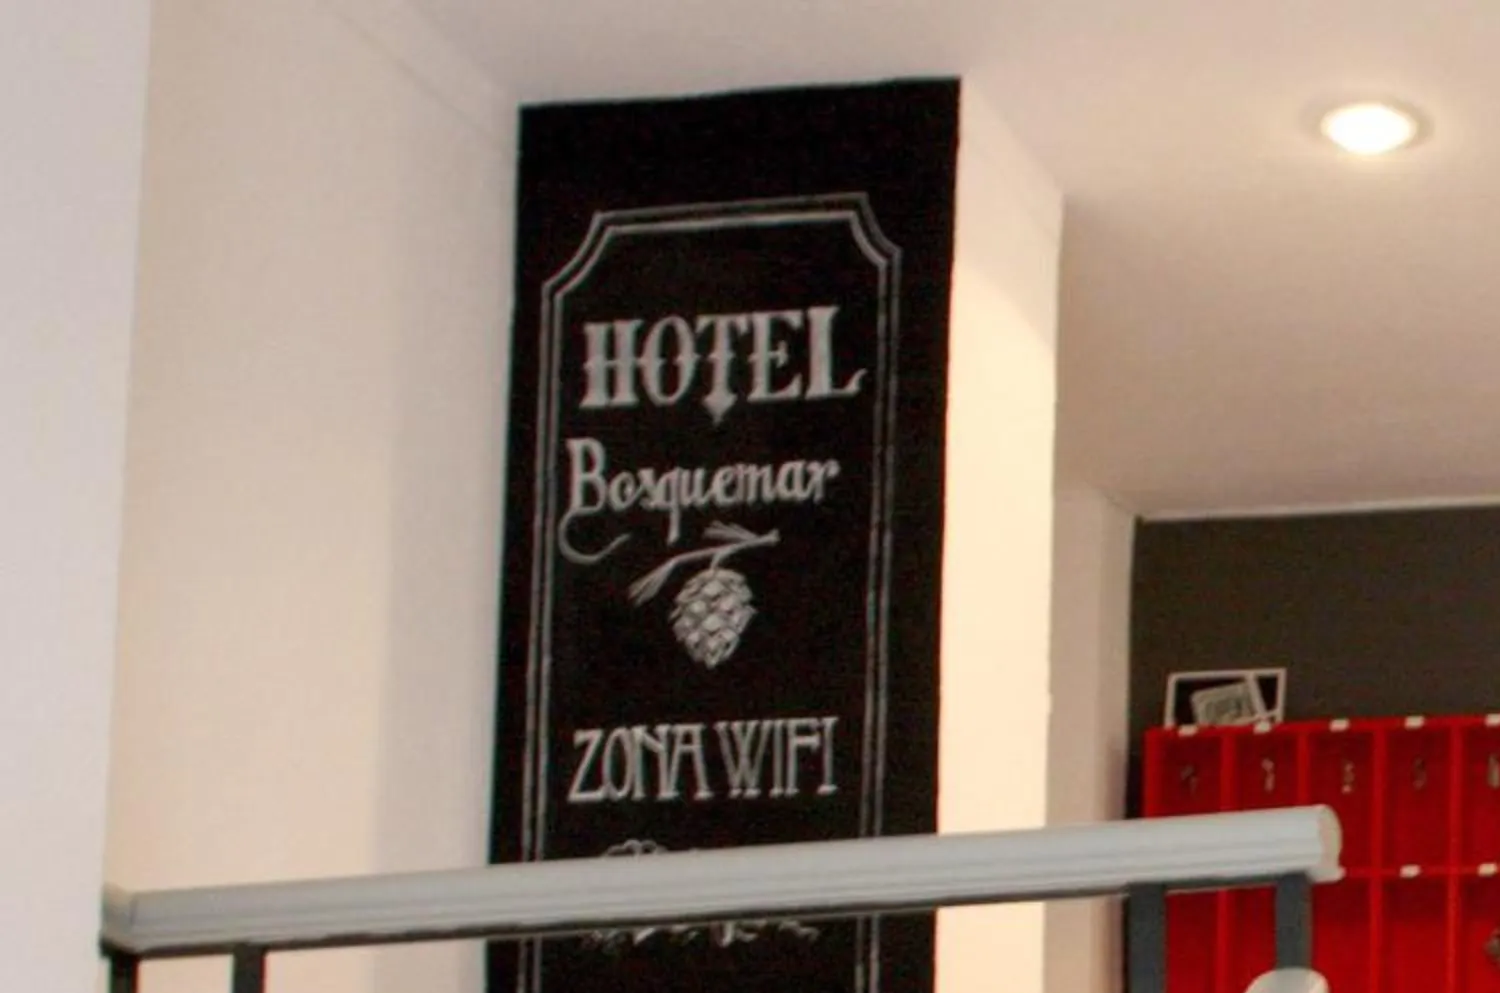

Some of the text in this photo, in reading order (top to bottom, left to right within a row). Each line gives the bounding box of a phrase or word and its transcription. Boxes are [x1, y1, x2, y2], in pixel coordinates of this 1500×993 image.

[579, 305, 868, 427] HOTEL
[558, 437, 841, 565] Bosquemar
[567, 716, 840, 803] ZONA WIFI
